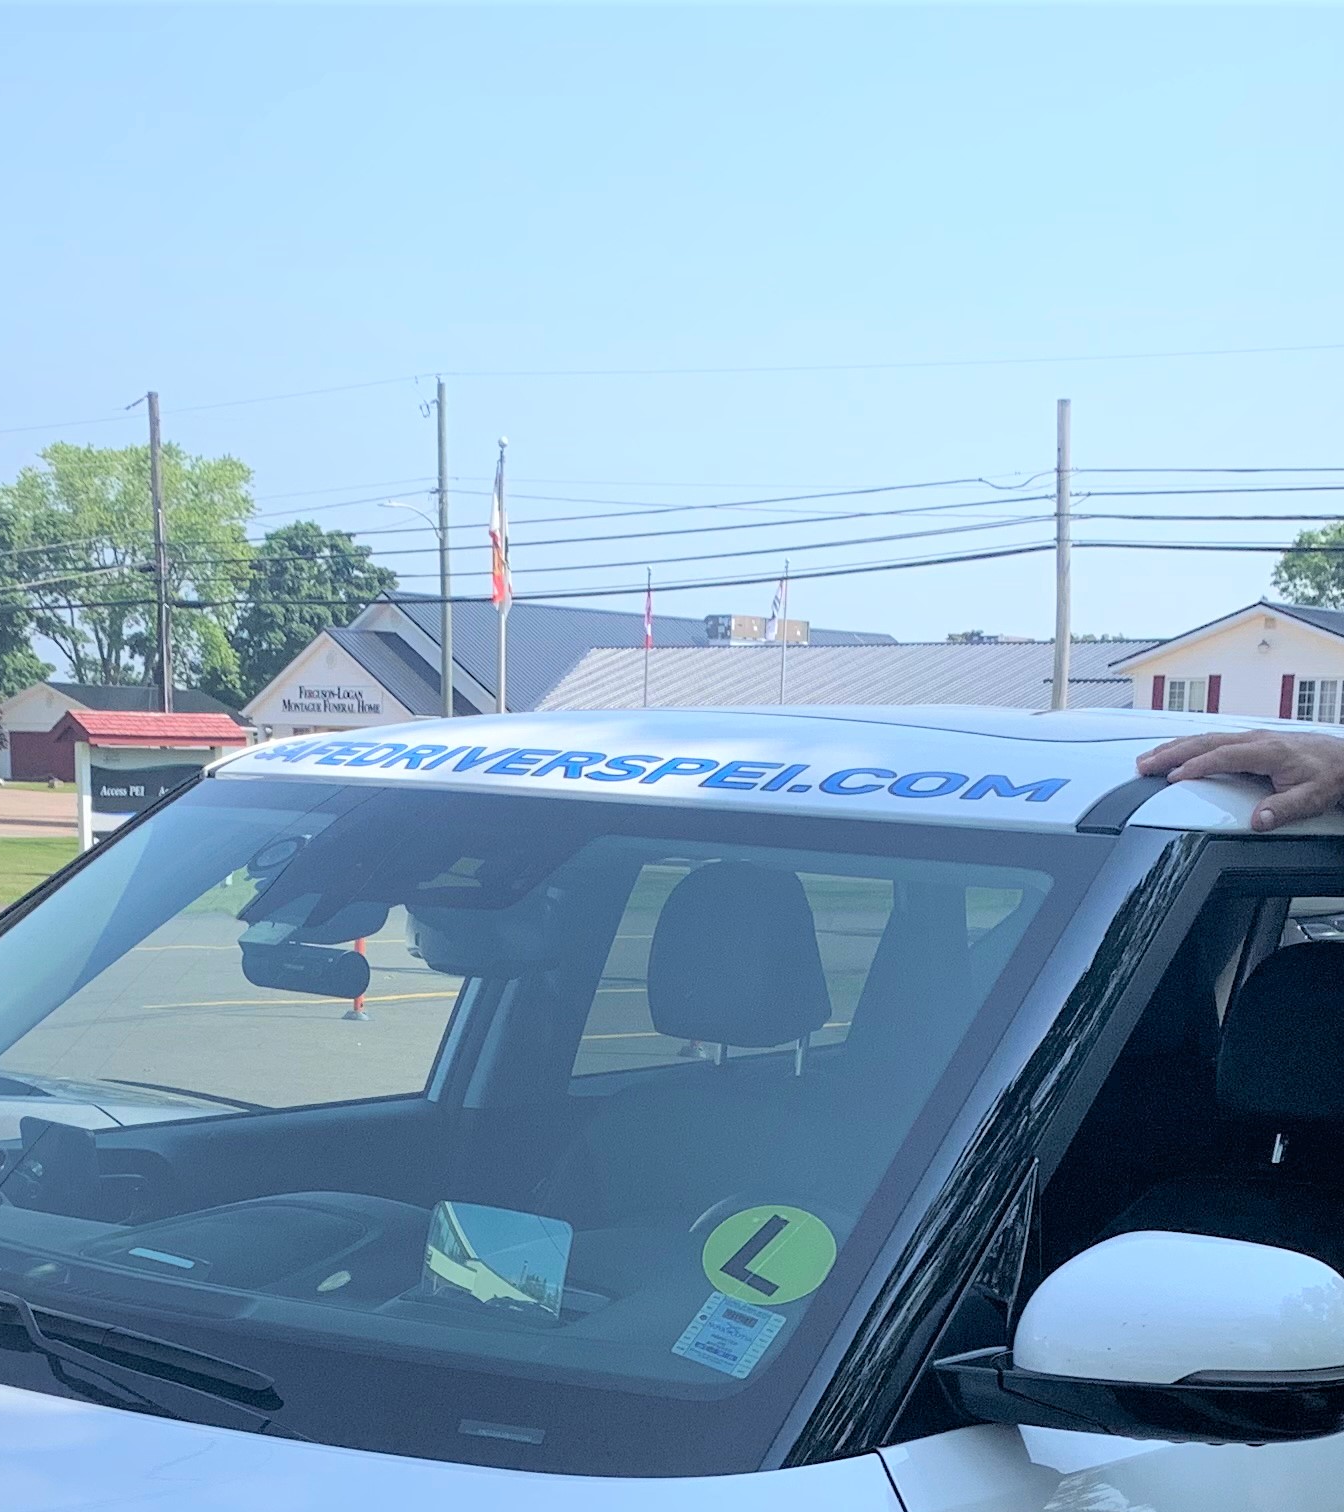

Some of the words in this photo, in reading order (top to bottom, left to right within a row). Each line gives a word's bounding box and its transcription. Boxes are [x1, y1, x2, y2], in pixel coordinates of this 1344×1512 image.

[298, 686, 363, 699] FERGUSON-LOGAN
[282, 699, 322, 713] MONTAGUE
[323, 699, 354, 714] FUNERAL
[357, 700, 381, 714] HOME
[254, 740, 1072, 803] SAFEDRIVERSPEI.COM
[99, 785, 128, 797] Access
[129, 785, 145, 797] PEI
[719, 1213, 791, 1298] L
